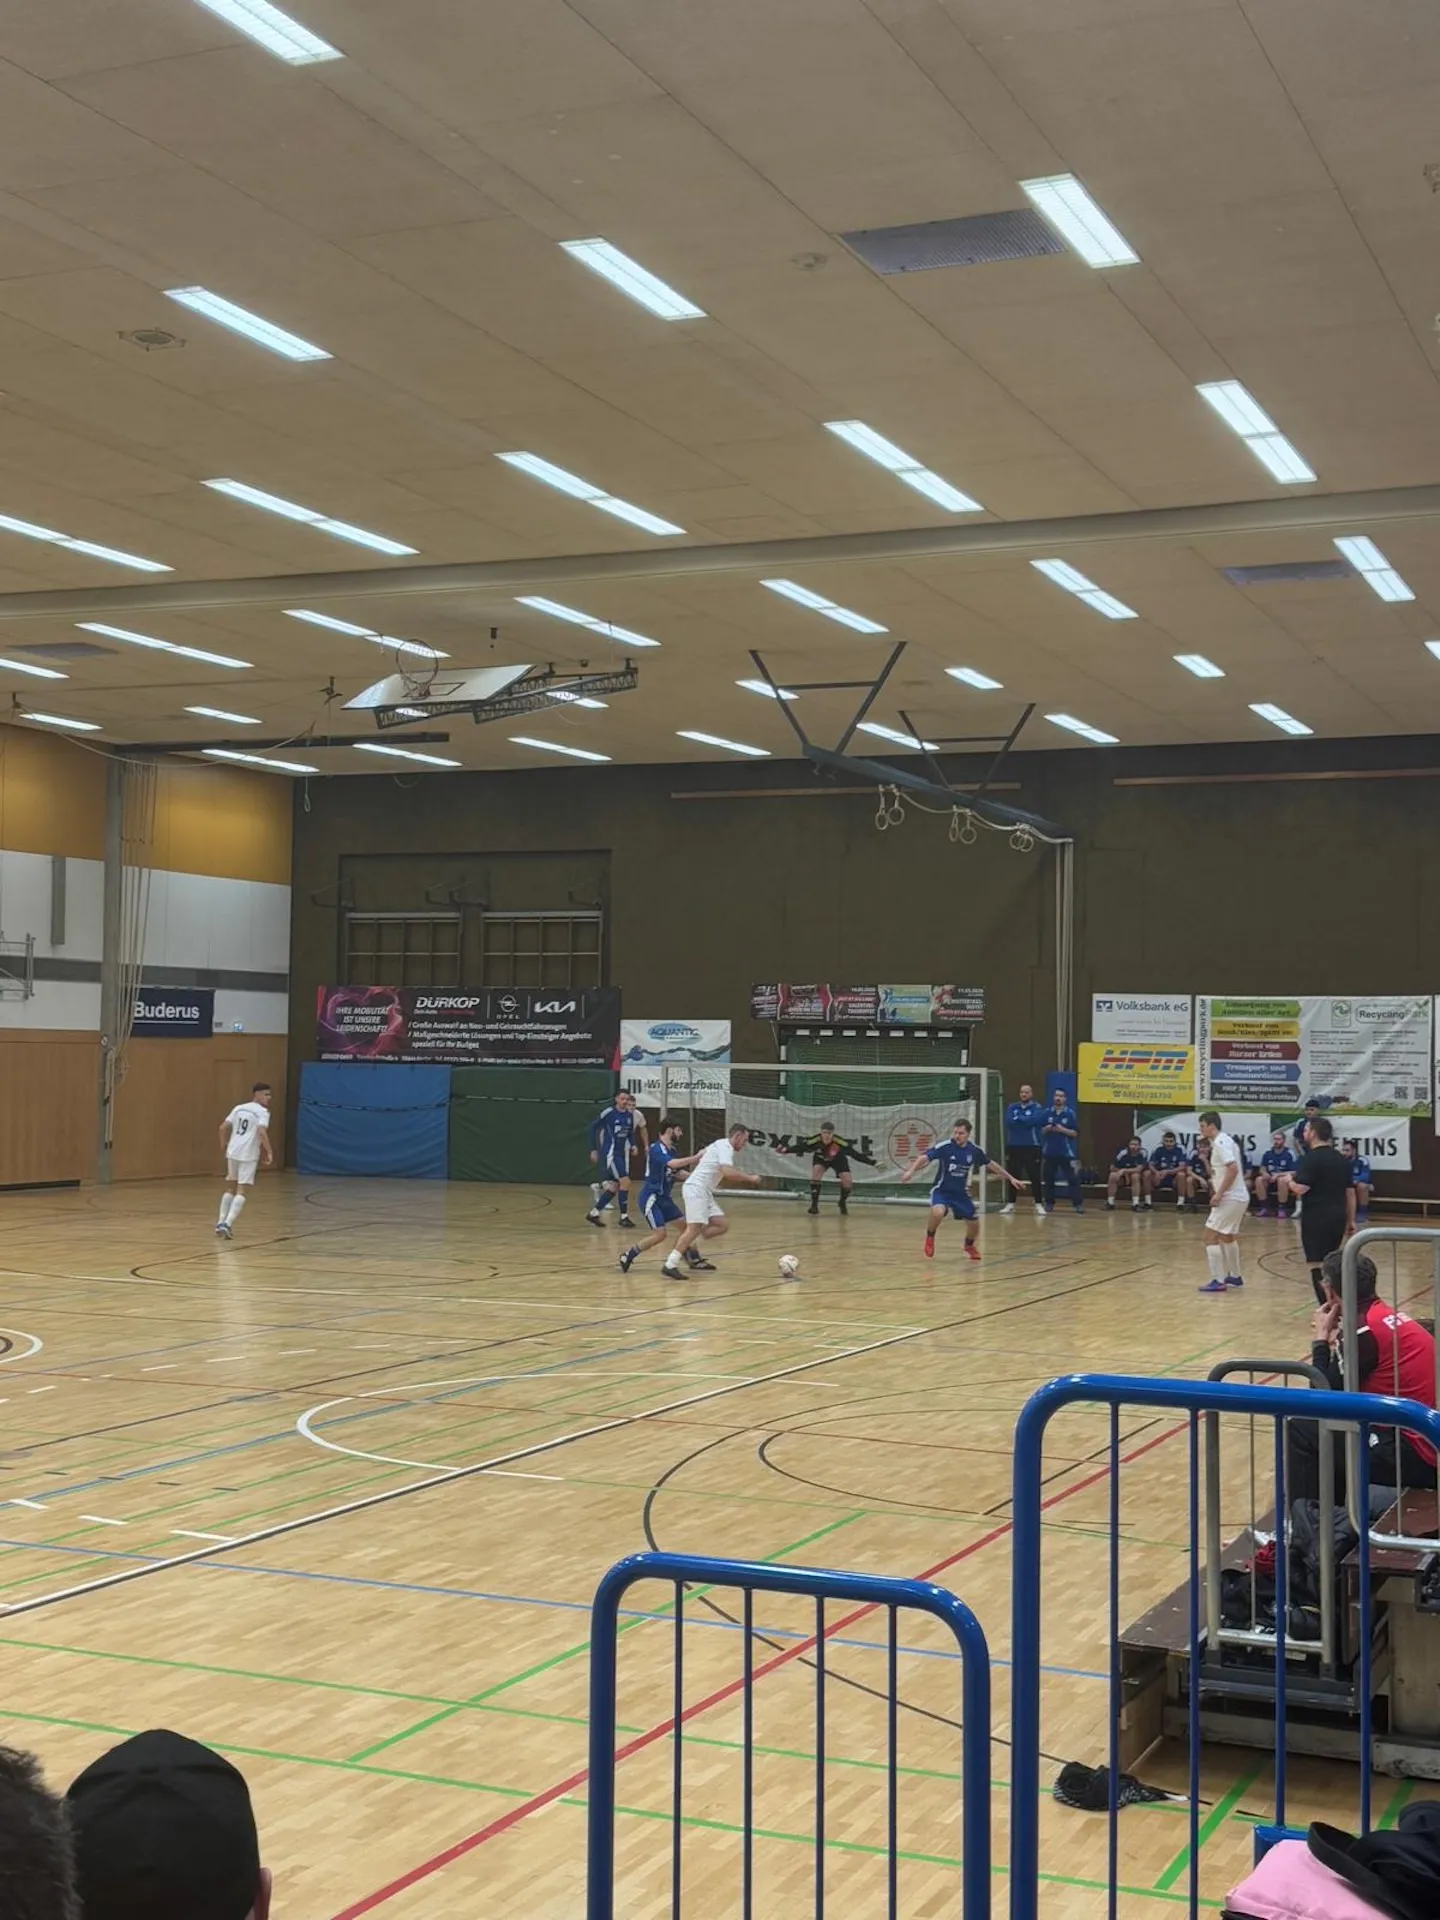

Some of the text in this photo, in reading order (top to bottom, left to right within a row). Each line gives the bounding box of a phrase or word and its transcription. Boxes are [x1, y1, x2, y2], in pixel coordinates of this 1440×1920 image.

[134, 1001, 200, 1019] Buderus
[1115, 1000, 1189, 1012] Volksbank eG
[486, 1022, 498, 1030] und
[235, 1116, 249, 1137] 19
